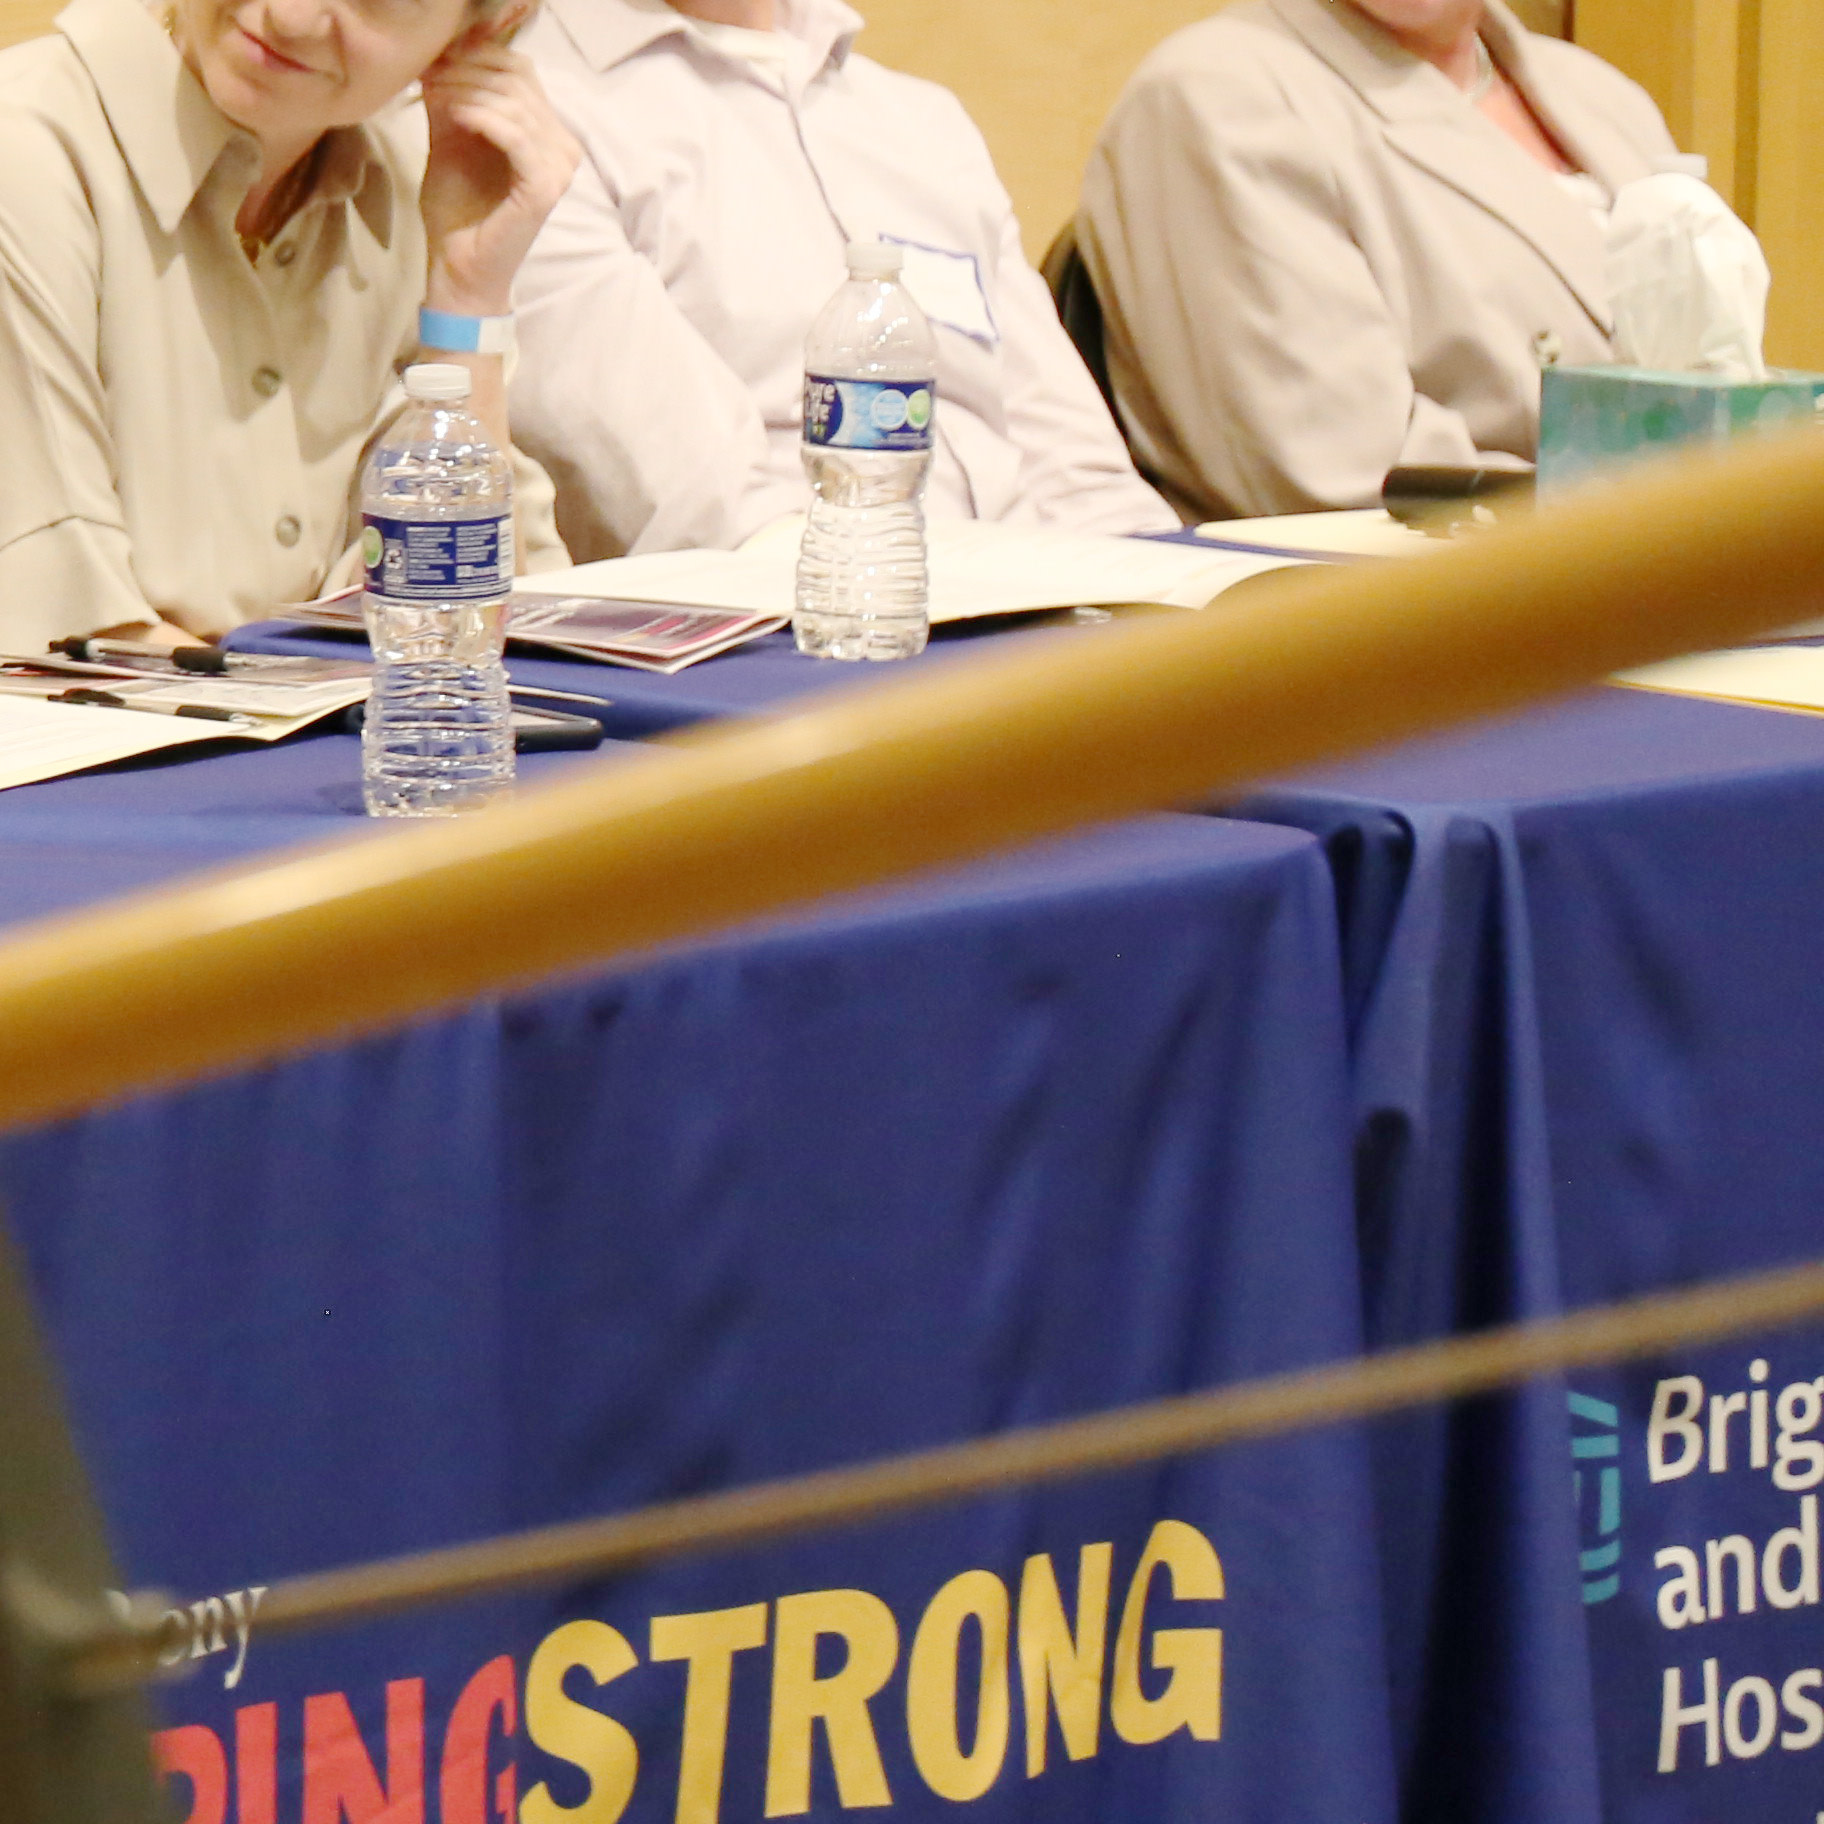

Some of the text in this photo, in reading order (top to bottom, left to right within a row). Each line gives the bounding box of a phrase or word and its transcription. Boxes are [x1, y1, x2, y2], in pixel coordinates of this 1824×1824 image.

[1647, 1358, 1824, 1492] Brig
[1655, 1494, 1821, 1631] and
[518, 1519, 1225, 1824] STRONG
[1657, 1657, 1824, 1774] Hos
